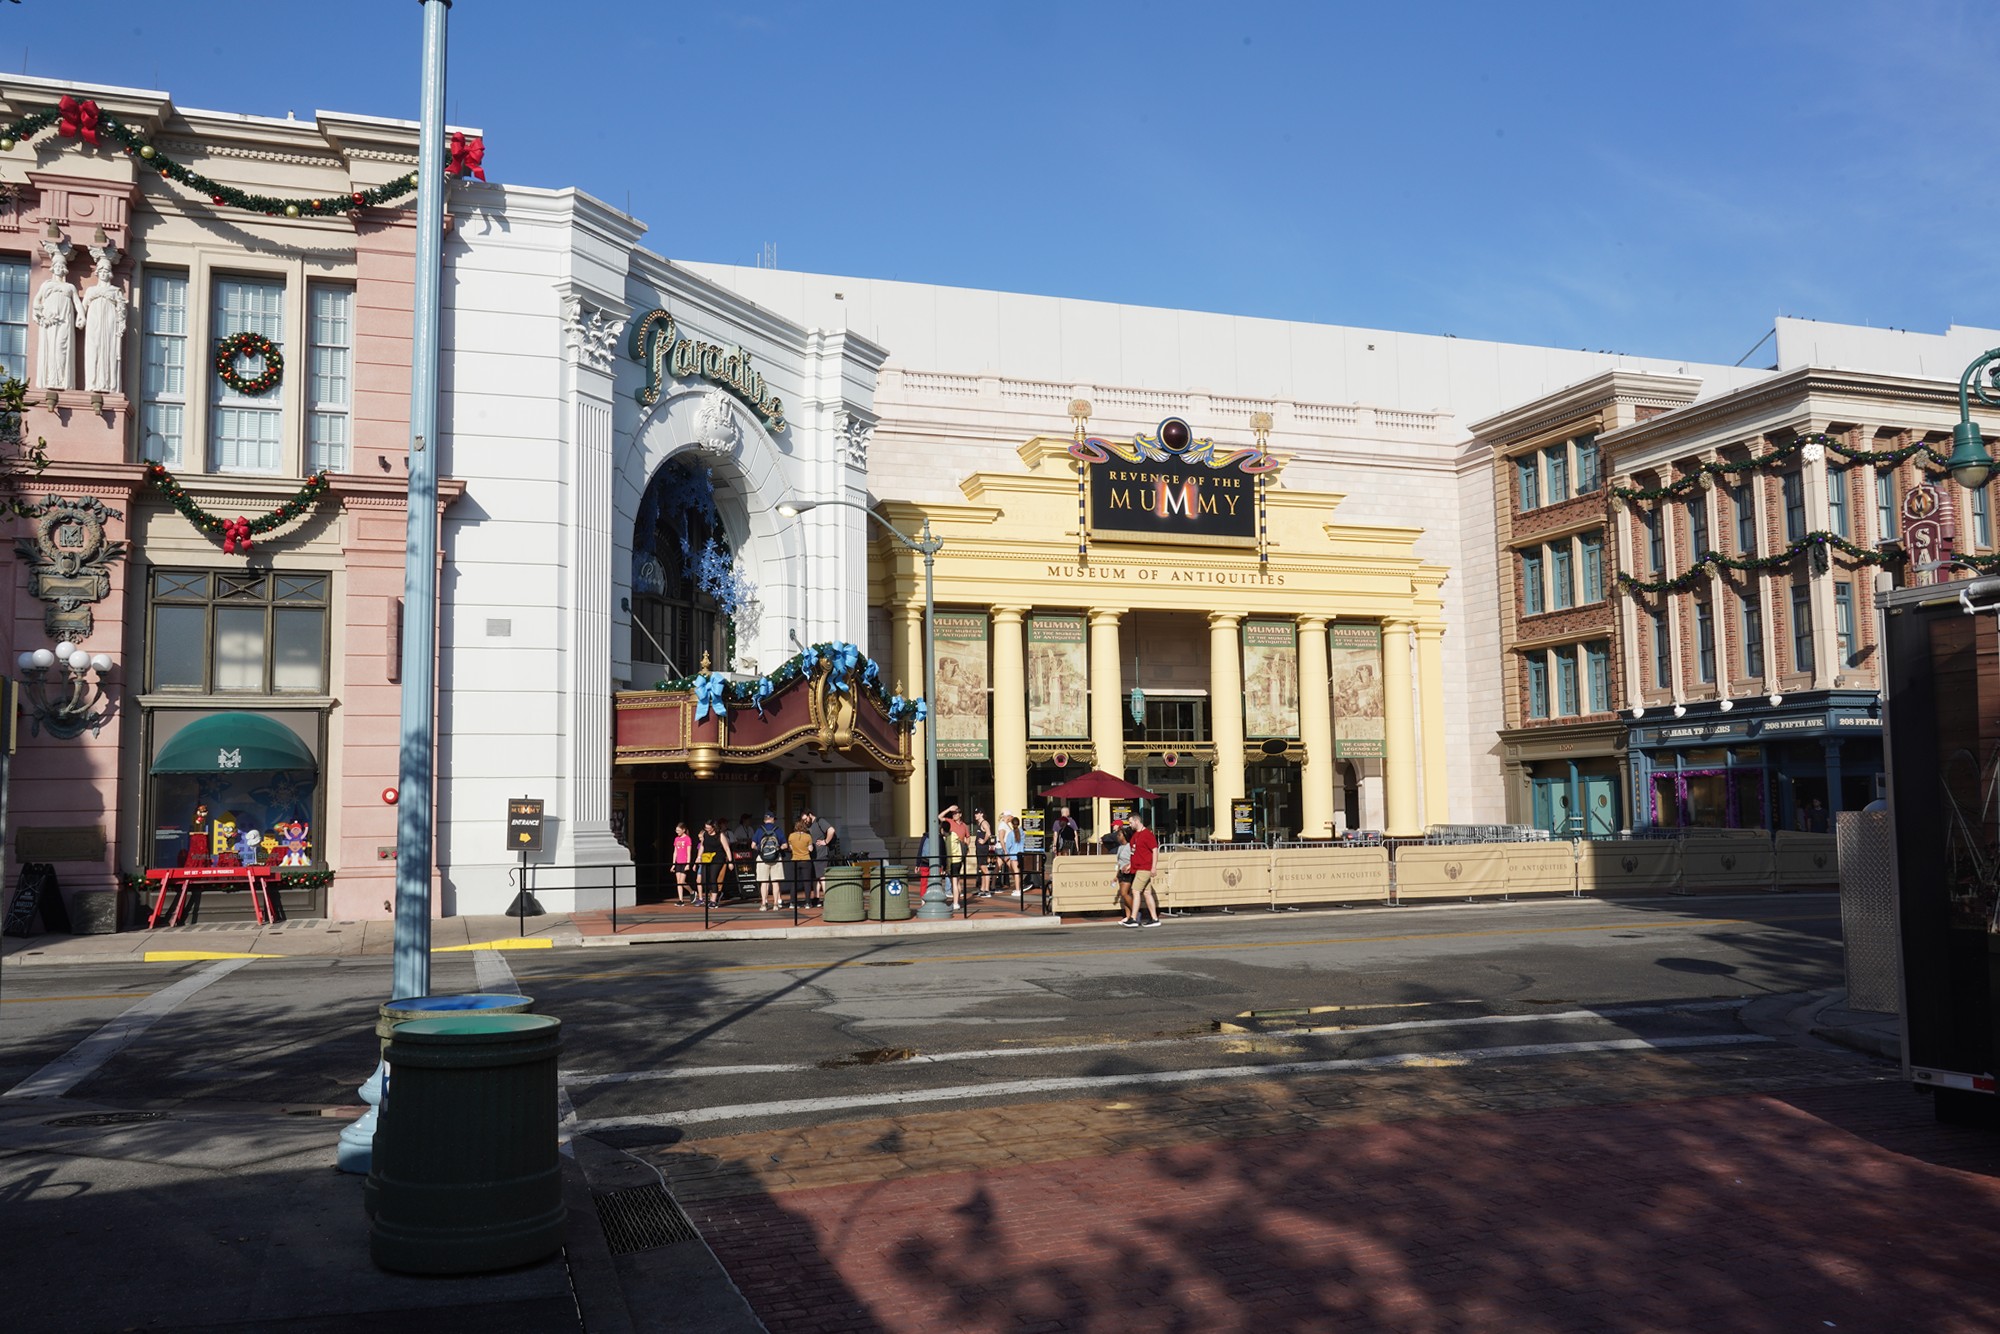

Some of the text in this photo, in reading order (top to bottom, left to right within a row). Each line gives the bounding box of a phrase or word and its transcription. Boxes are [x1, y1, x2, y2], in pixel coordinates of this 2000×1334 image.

[1109, 470, 1241, 488] REVENGE OF THE
[1109, 482, 1240, 516] MUMMY
[1047, 565, 1285, 586] MUSEUM OF ANTIQUITIES
[933, 618, 983, 626] MUMMY
[1032, 621, 1082, 629] MUMMY
[1247, 626, 1292, 634] MUMMY
[1764, 721, 1780, 730] 208
[1780, 720, 1804, 729] FIFTH
[1839, 717, 1855, 726] 208
[1855, 718, 1879, 726] FIFTH
[1661, 725, 1731, 738] SAHARA TRADERS
[1521, 863, 1568, 872] ANTIQUITIES
[1278, 871, 1382, 881] MUSEUM OF ANTIQUITIES
[1061, 881, 1099, 889] MUSEUM
